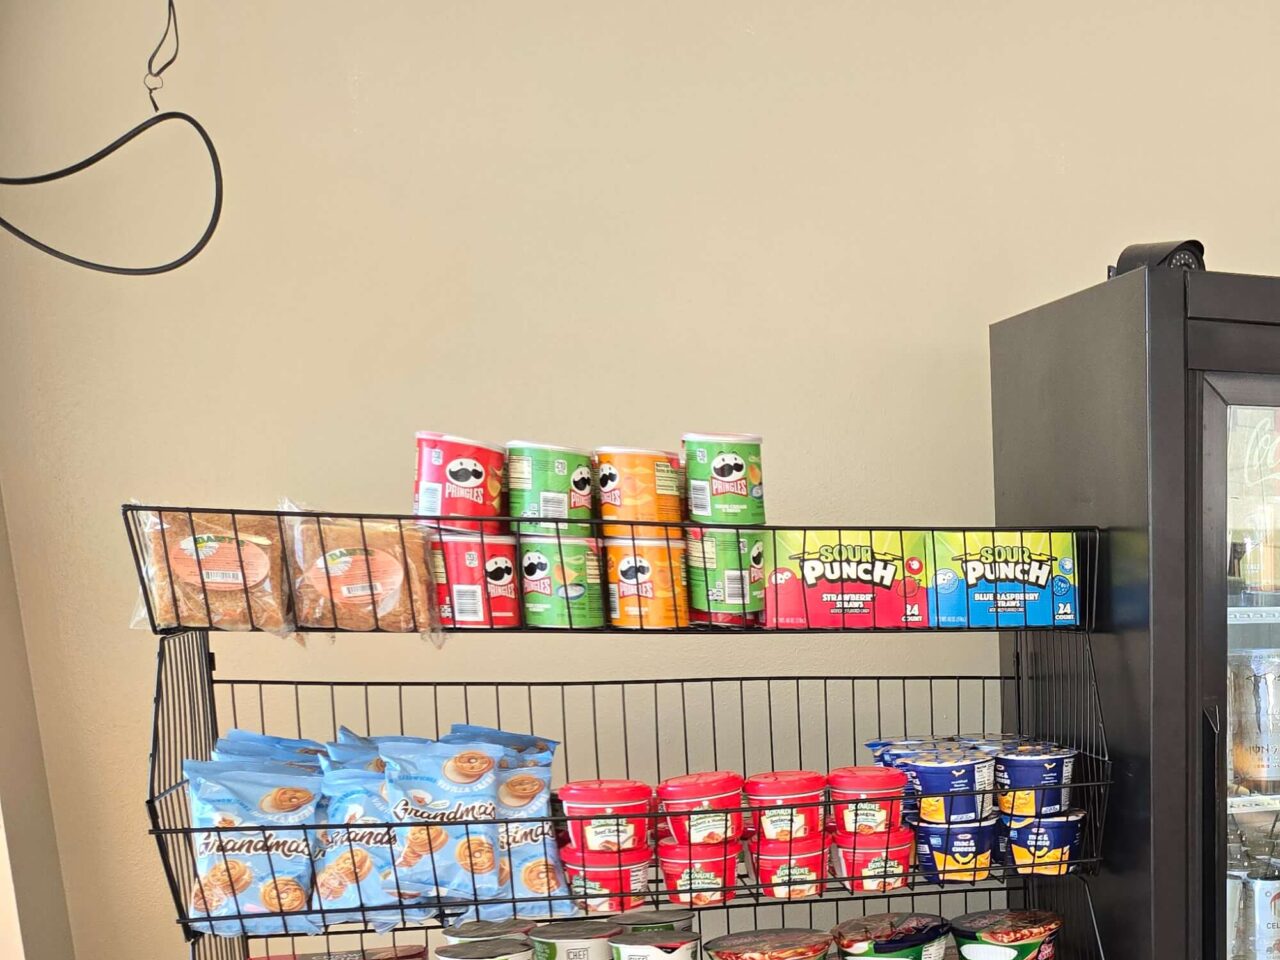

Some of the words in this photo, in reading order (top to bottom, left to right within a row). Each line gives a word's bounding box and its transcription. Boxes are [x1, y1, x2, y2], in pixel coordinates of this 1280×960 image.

[445, 482, 484, 504] PRINGLES
[711, 477, 748, 497] PRINGLES
[819, 545, 872, 562] SOUR
[980, 546, 1031, 563] SOUR
[802, 559, 897, 589] PUNCH
[964, 561, 1051, 587] PUNCH
[974, 593, 994, 601] BLUE
[1057, 602, 1072, 614] 24
[568, 951, 586, 960] CHEF
